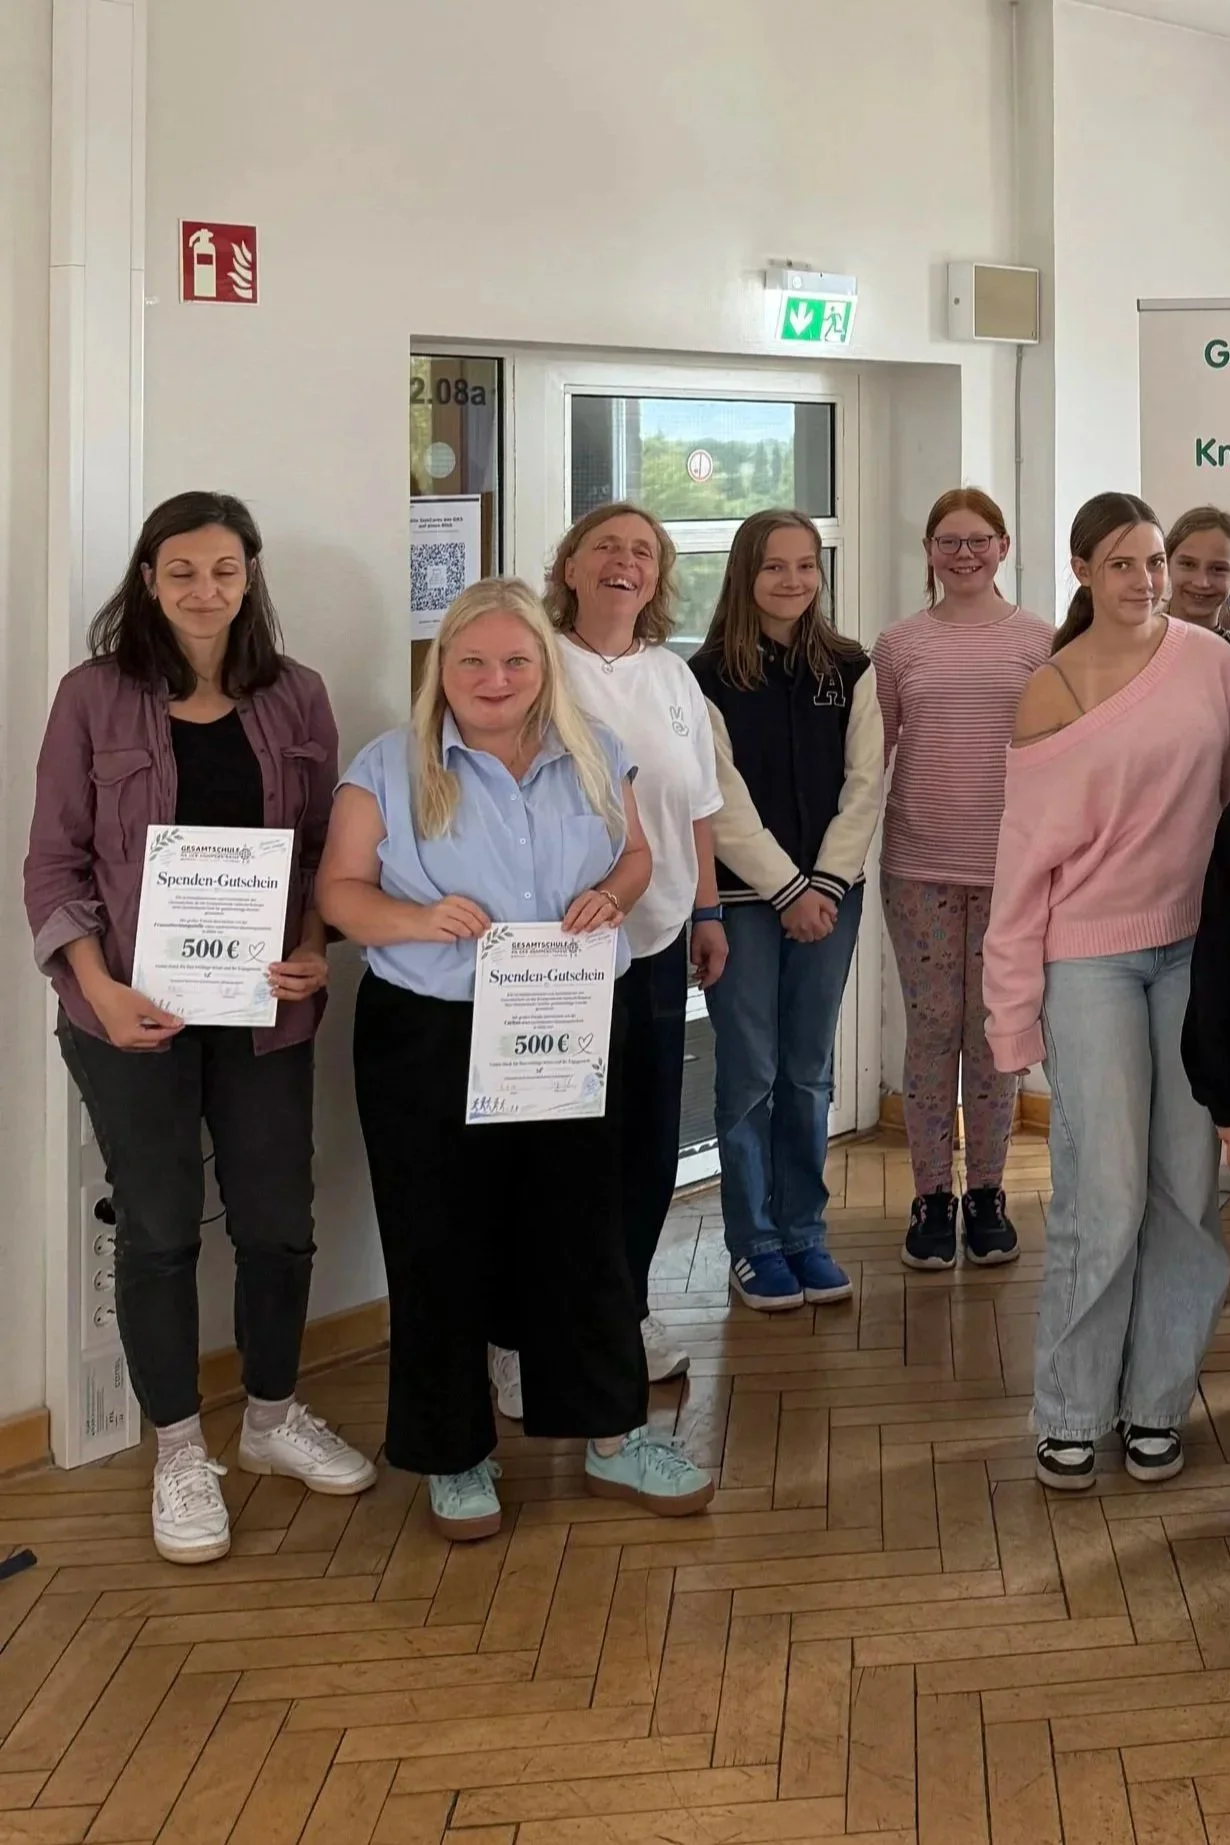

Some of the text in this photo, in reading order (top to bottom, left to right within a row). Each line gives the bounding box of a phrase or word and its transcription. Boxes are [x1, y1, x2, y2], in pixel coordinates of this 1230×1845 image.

[410, 377, 486, 405] 2.08a
[156, 871, 279, 889] Spenden-Gutschein
[181, 938, 240, 959] 500 €
[489, 968, 605, 985] Spenden-Gutschein
[514, 1033, 570, 1055] 500 €
